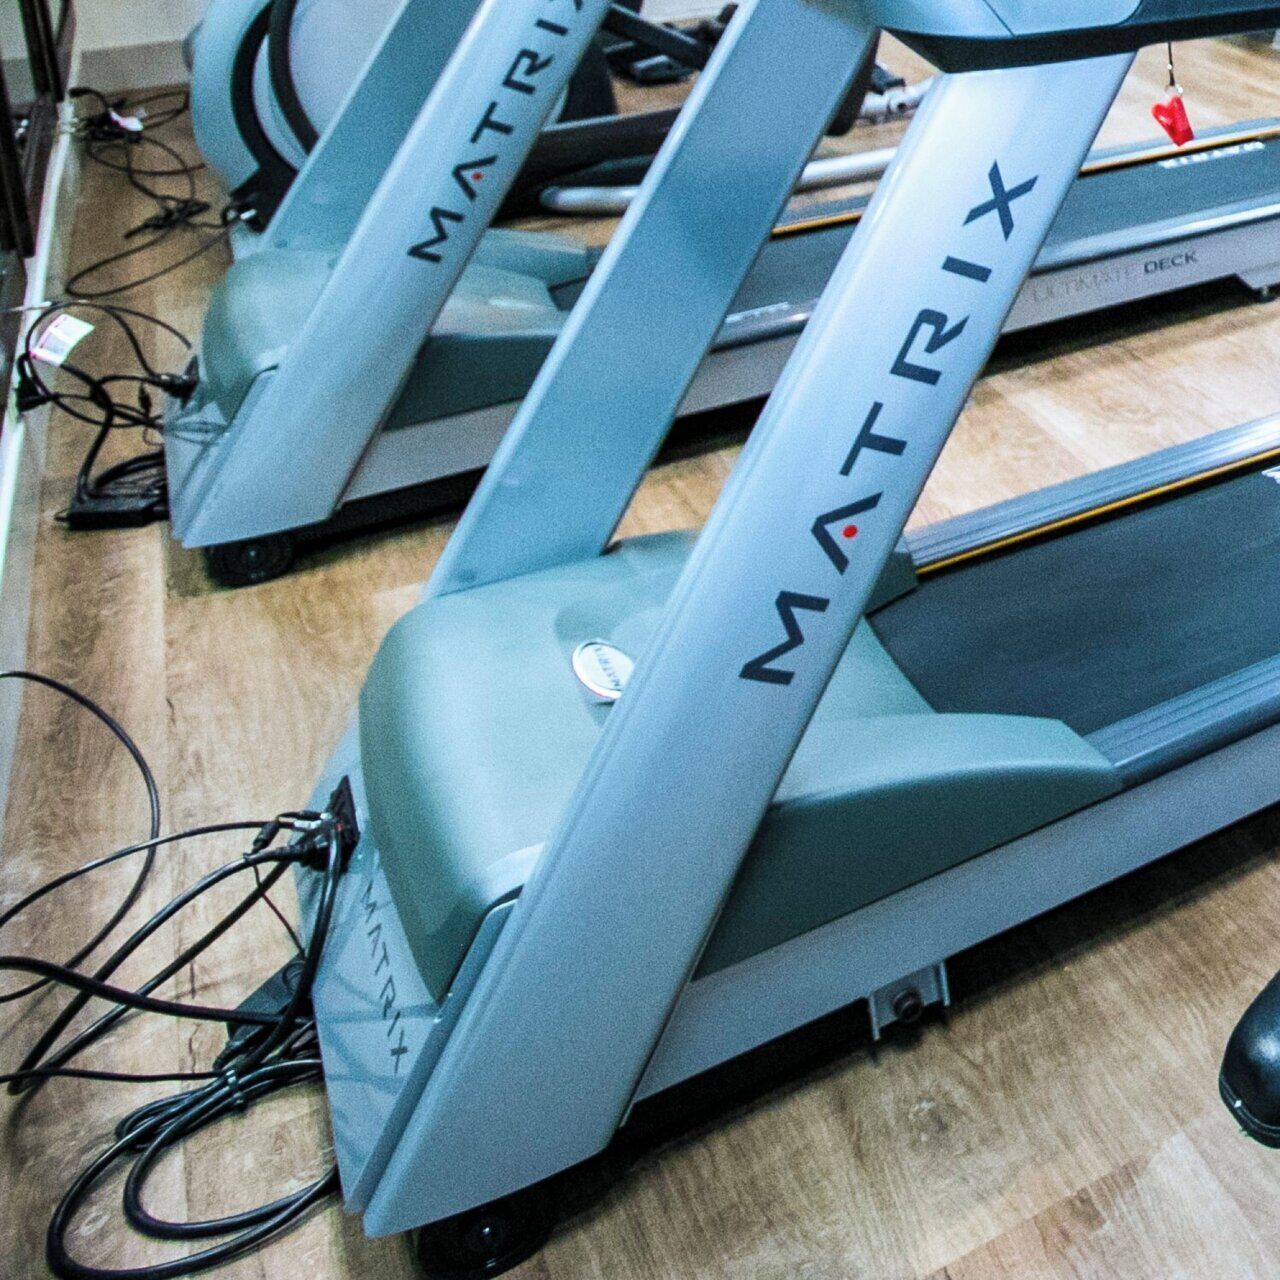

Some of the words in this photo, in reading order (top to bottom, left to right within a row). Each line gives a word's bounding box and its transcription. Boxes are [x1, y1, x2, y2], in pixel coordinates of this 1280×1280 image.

[1144, 251, 1198, 274] DECK
[739, 159, 1039, 686] MATRIX
[361, 879, 409, 1075] MATRIX
